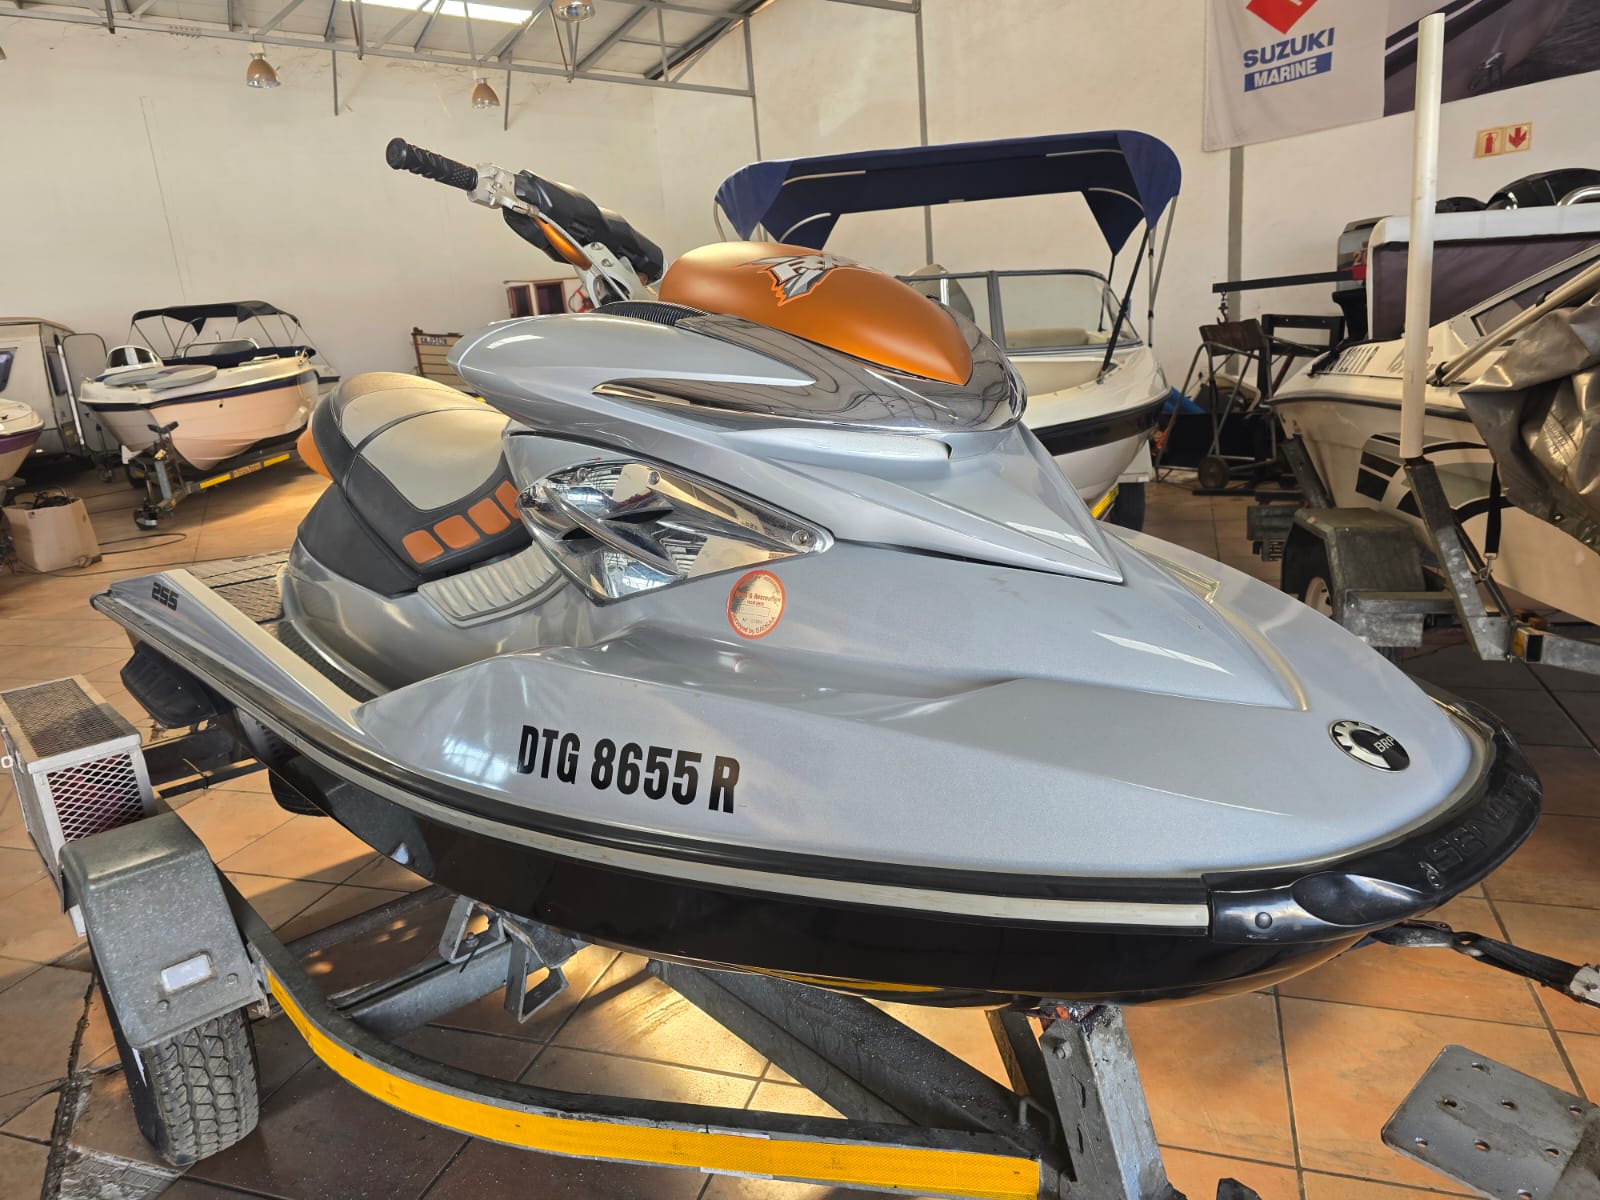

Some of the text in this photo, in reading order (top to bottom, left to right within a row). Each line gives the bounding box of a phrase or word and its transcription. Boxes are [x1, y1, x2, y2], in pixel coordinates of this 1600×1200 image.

[1243, 27, 1335, 68] SUZUKI
[1253, 57, 1317, 88] MARINE
[152, 581, 179, 611] 255
[1373, 735, 1395, 752] BRP
[516, 724, 741, 814] DTG 8655 R
